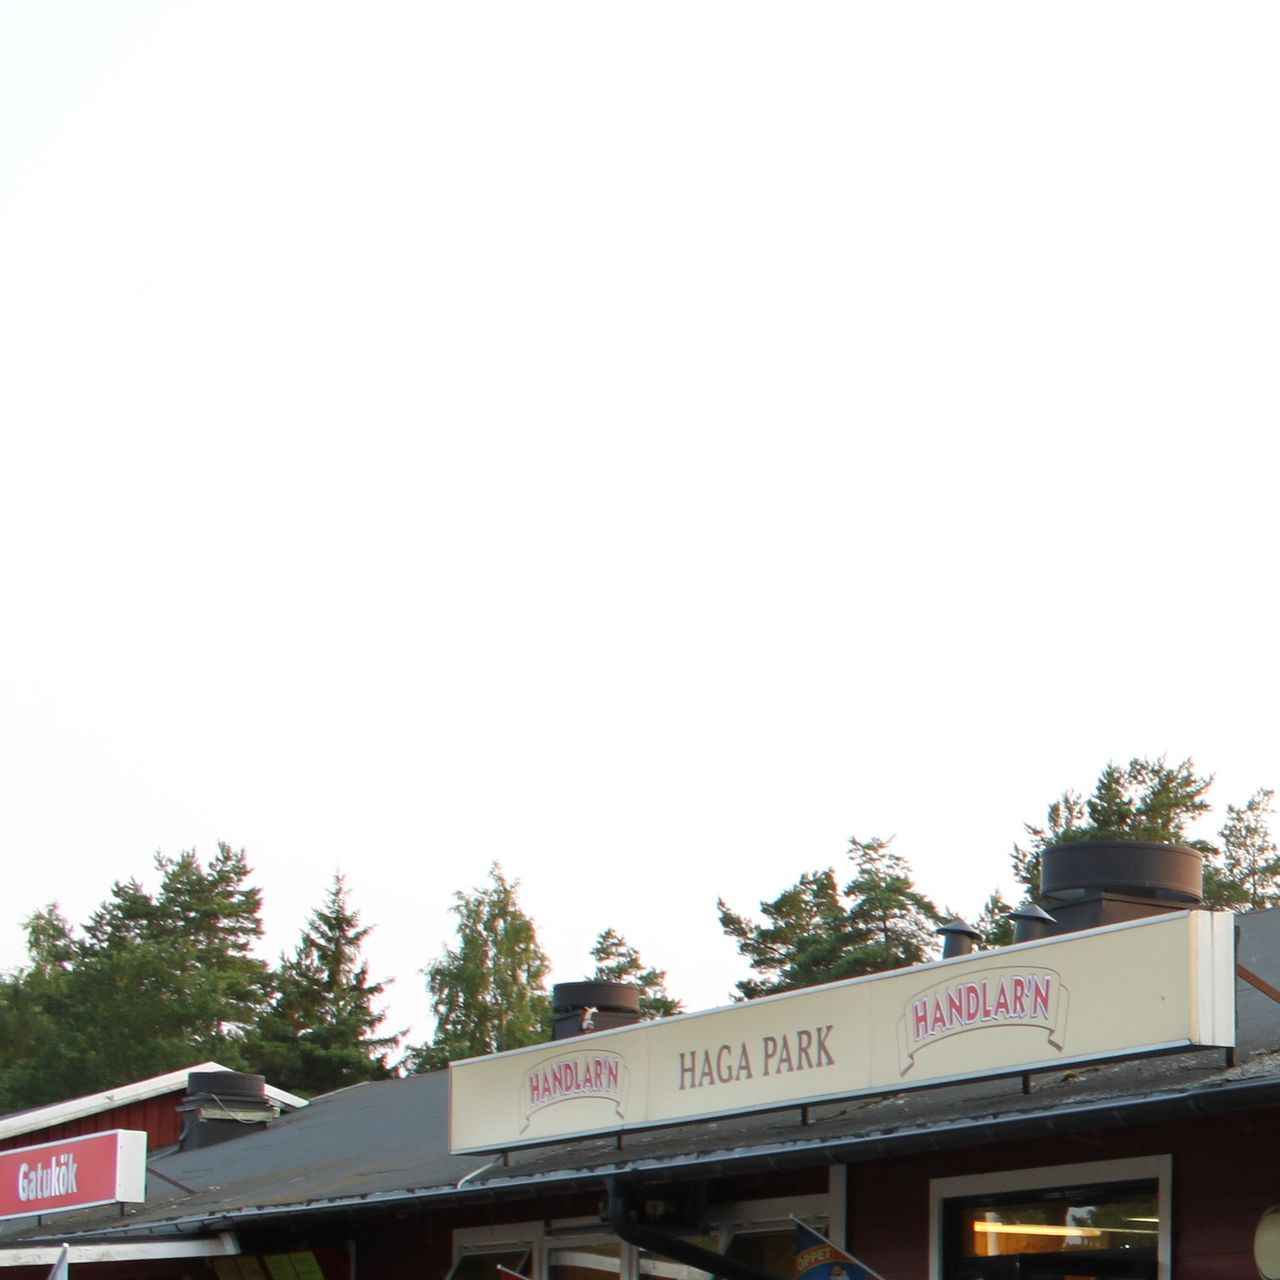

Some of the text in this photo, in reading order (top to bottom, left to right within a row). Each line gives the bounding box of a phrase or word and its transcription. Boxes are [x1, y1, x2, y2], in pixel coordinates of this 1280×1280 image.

[912, 973, 1052, 1042] HANDLAR'N
[678, 1024, 835, 1090] HAGA PARK
[18, 1153, 78, 1201] Gatukök
